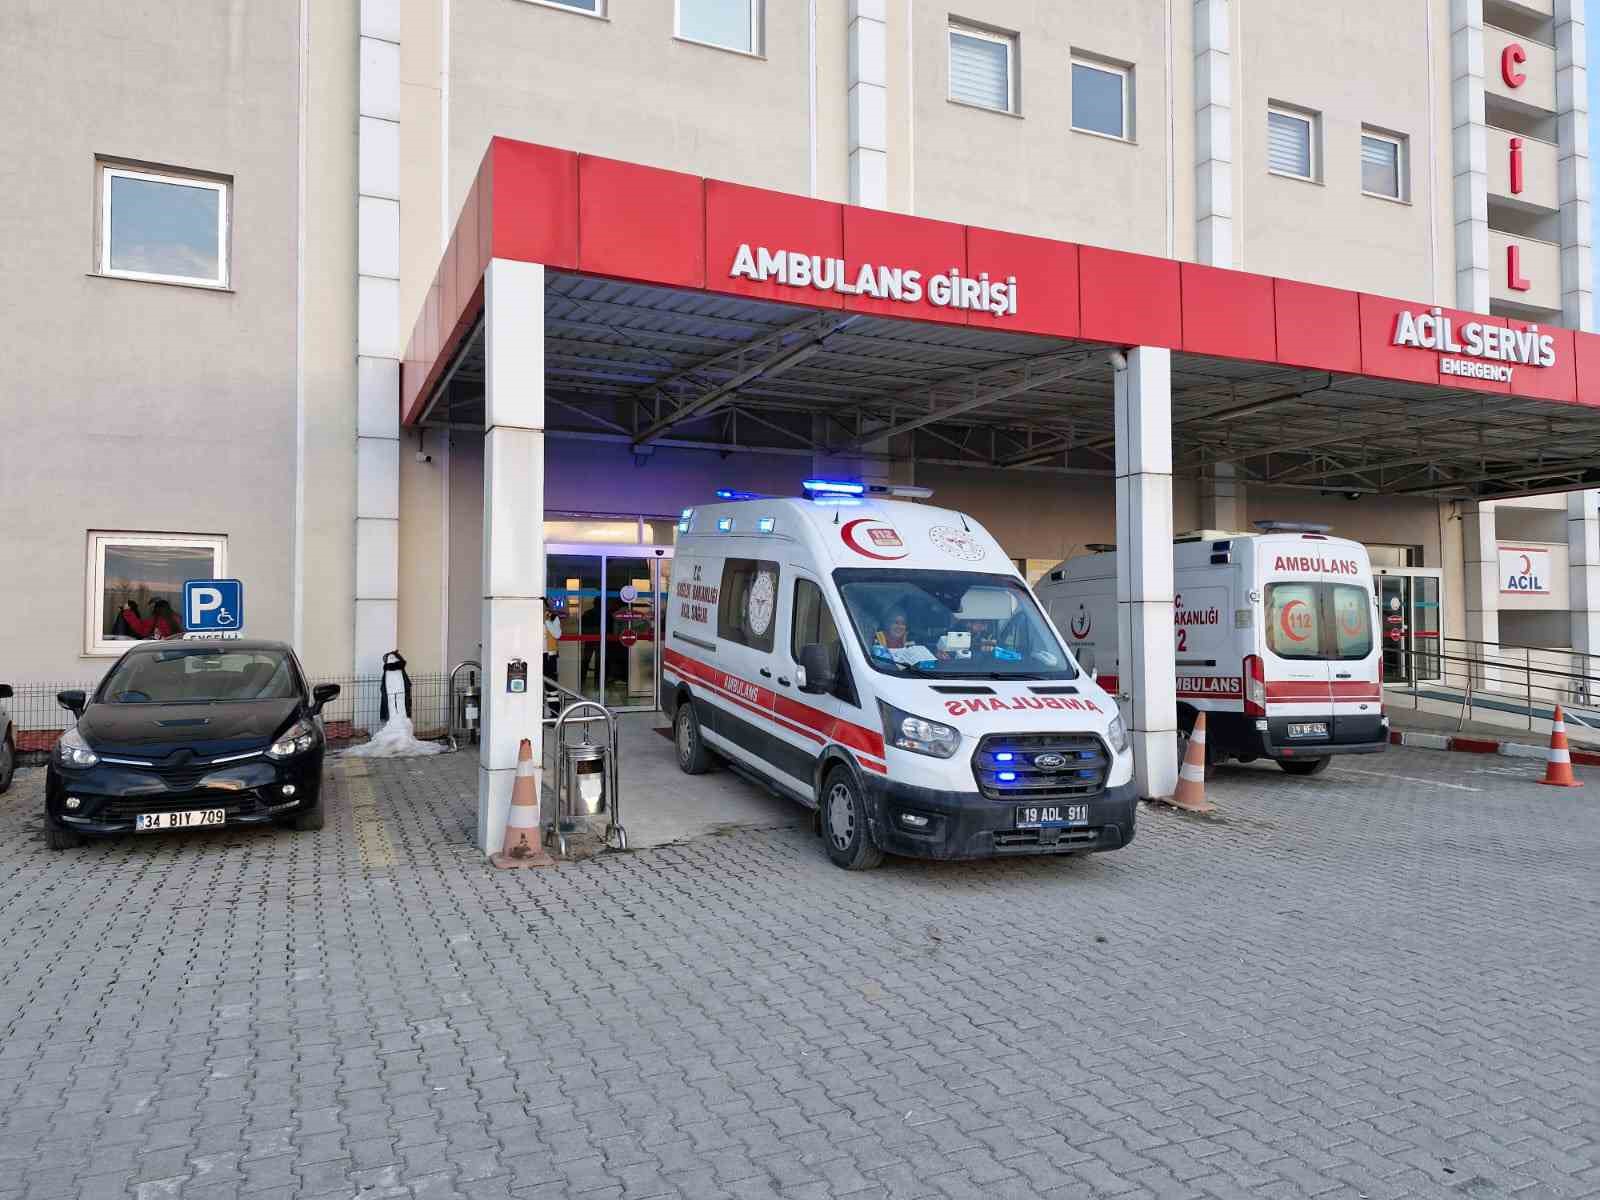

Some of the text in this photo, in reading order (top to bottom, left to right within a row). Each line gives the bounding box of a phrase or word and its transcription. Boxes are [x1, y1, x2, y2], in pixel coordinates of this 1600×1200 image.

[1501, 43, 1531, 292] CİL
[730, 244, 1017, 317] AMBULANS GİRİŞİ
[1393, 307, 1556, 367] ACİL SERVİS
[1440, 358, 1513, 383] EMERGENCY
[1274, 556, 1358, 574] AMBULANS
[191, 588, 223, 624] P
[1174, 606, 1218, 625] AKANLIĞI
[723, 675, 759, 702] AMBULANS
[1176, 677, 1239, 692] MBULANS
[145, 810, 223, 828] 34 BIY 709
[1025, 806, 1086, 822] 19 ADL 911
